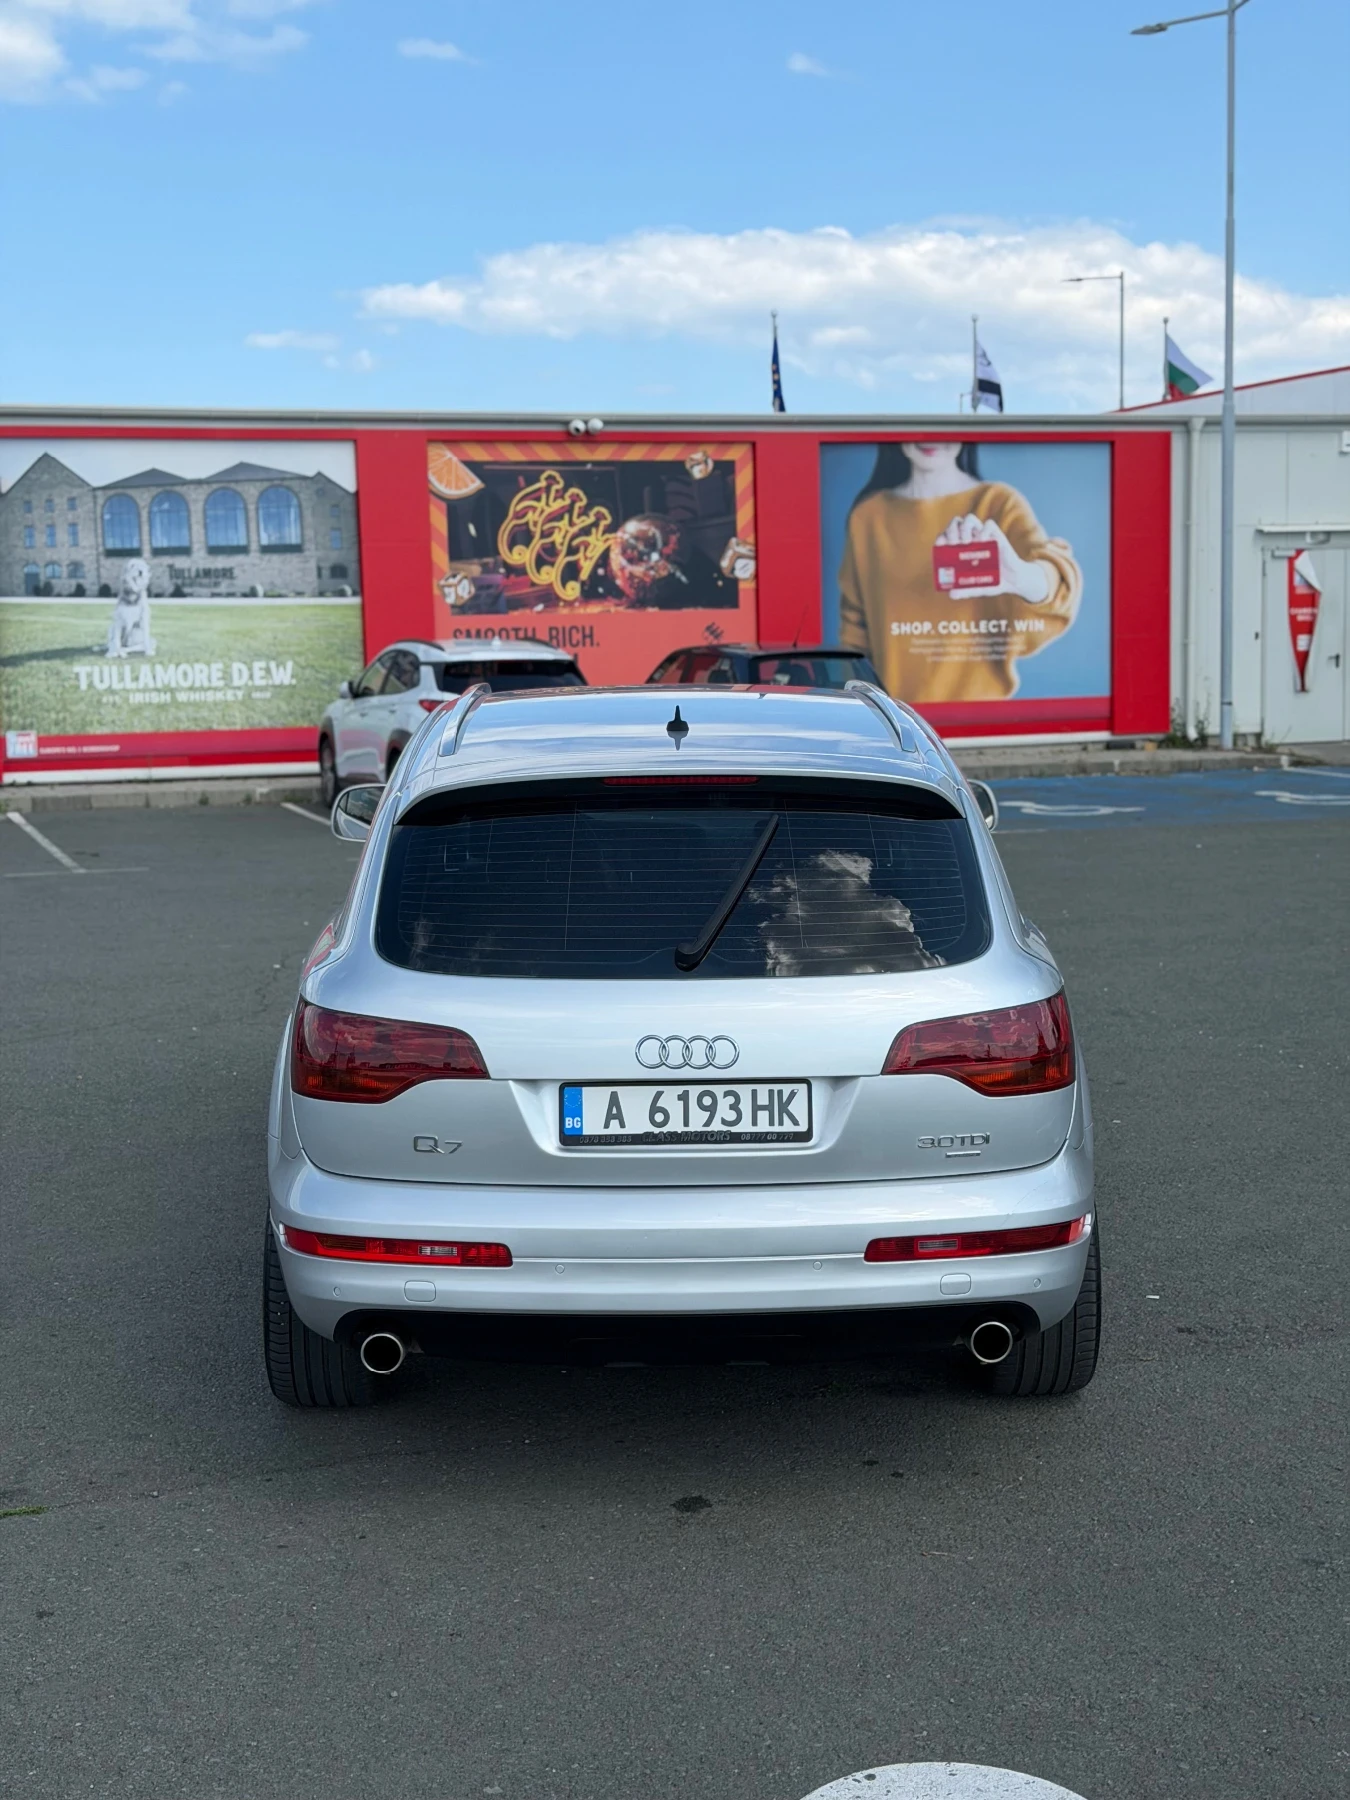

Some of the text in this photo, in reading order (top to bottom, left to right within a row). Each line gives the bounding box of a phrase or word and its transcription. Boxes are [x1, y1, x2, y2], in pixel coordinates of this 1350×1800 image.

[890, 621, 935, 636] SHOP.
[937, 619, 1011, 634] COLLECT.
[548, 625, 600, 649] RICH.
[73, 660, 297, 691] TULLAMORE D.E.W.
[128, 691, 172, 704] IRISH
[175, 688, 245, 703] WHISKEY
[603, 1088, 801, 1130] A 6193 HK
[565, 1117, 581, 1129] BG
[413, 1135, 463, 1154] Q7
[680, 1130, 731, 1142] MOTORS
